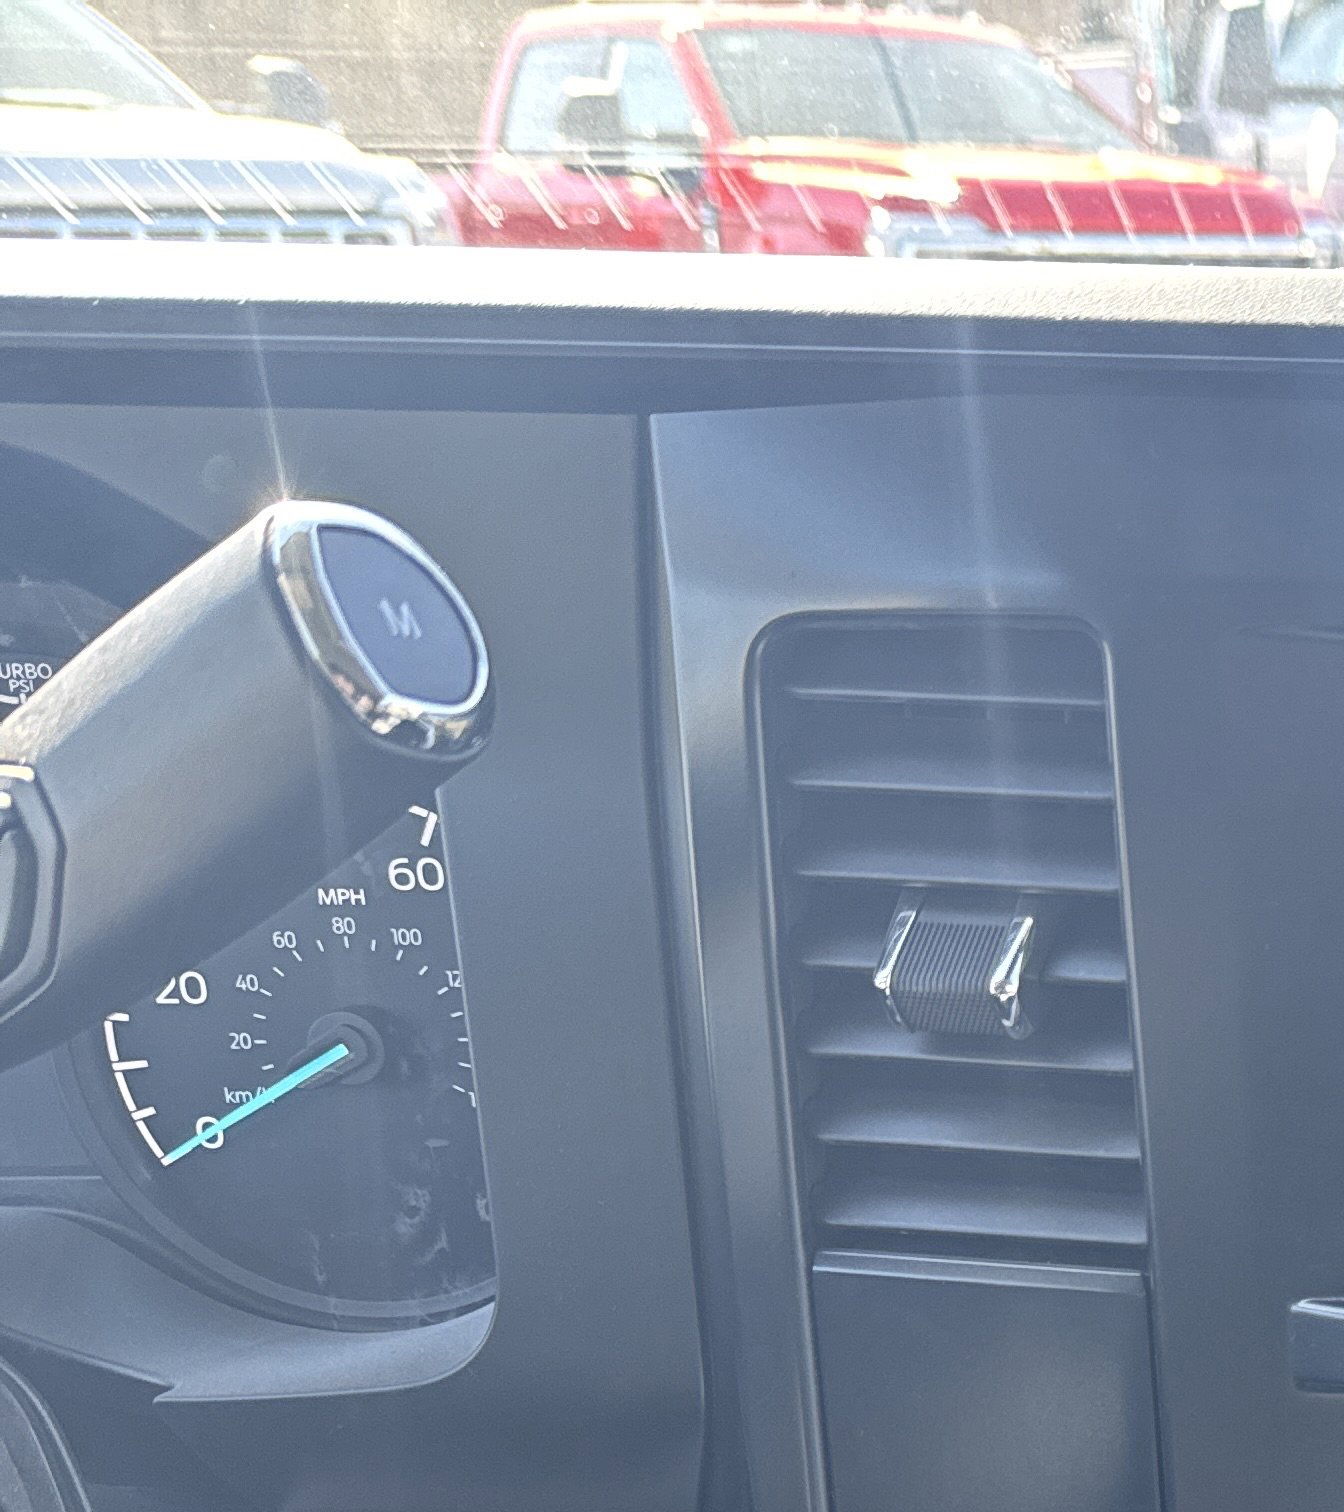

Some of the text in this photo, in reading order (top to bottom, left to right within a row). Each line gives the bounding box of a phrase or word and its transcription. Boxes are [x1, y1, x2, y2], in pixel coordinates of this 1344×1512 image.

[379, 598, 421, 640] M
[8, 679, 35, 693] PSI
[388, 857, 445, 891] 60
[317, 888, 366, 906] MPH
[331, 916, 356, 935] 80
[272, 930, 297, 949] 60
[390, 927, 422, 946] 100
[235, 973, 259, 992] 40
[228, 1032, 252, 1050] 20
